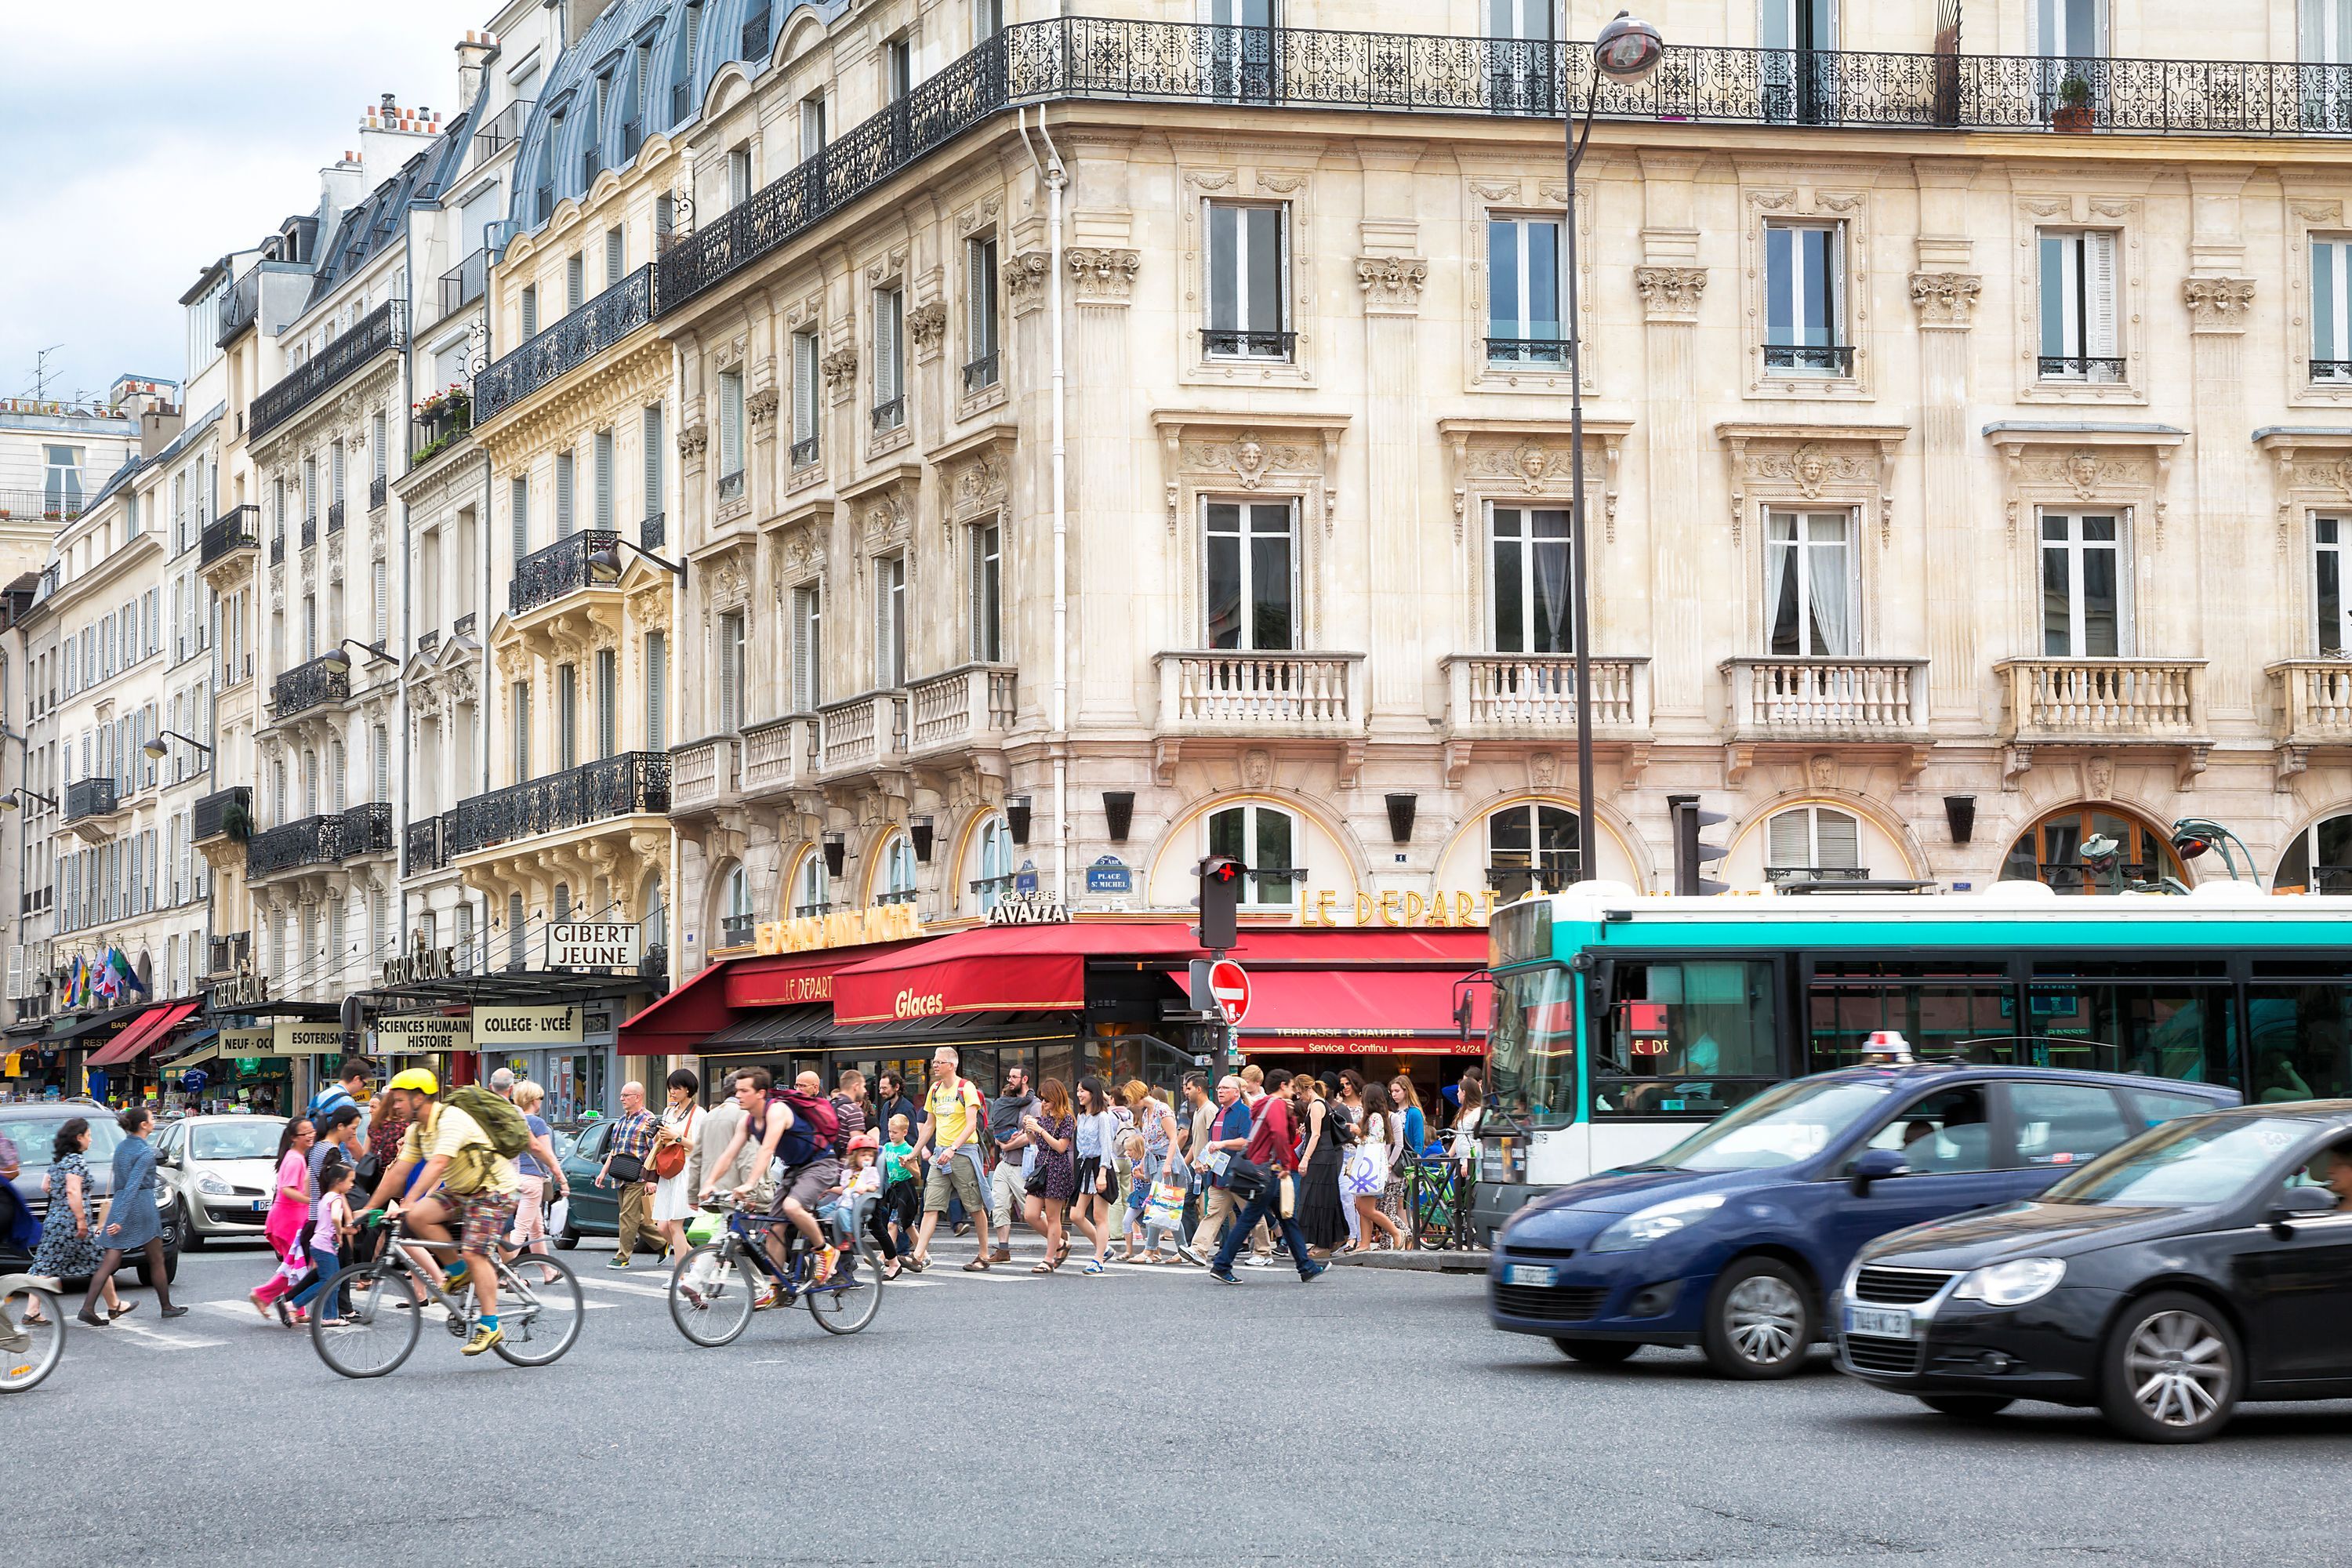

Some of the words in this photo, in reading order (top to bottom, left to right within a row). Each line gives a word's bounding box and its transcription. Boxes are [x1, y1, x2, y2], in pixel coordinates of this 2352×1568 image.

[985, 902, 1066, 924] LAVAZZA
[1301, 890, 1336, 927] LE
[1355, 890, 1501, 927] DEPART
[554, 924, 635, 942] GIBERT
[558, 947, 630, 964] JEUNE
[382, 956, 410, 988] GIBERT
[420, 947, 452, 982] JEUNE
[213, 980, 236, 1009] GIBERT
[241, 977, 265, 1006] JEUNE
[786, 978, 796, 1001] LE
[797, 975, 833, 1000] DEPART
[895, 988, 943, 1018] Glaces
[379, 1020, 424, 1033] SCIENCES
[485, 1018, 532, 1032] COLLEGE
[1274, 1028, 1342, 1038] TERRASSE
[1347, 1029, 1415, 1038] CHAUFFEE
[224, 1039, 249, 1050] NEUF
[408, 1034, 452, 1047] HISTOIRE
[1308, 1043, 1345, 1053] Service
[1349, 1043, 1388, 1053] Continu
[1455, 1044, 1481, 1054] 24/24
